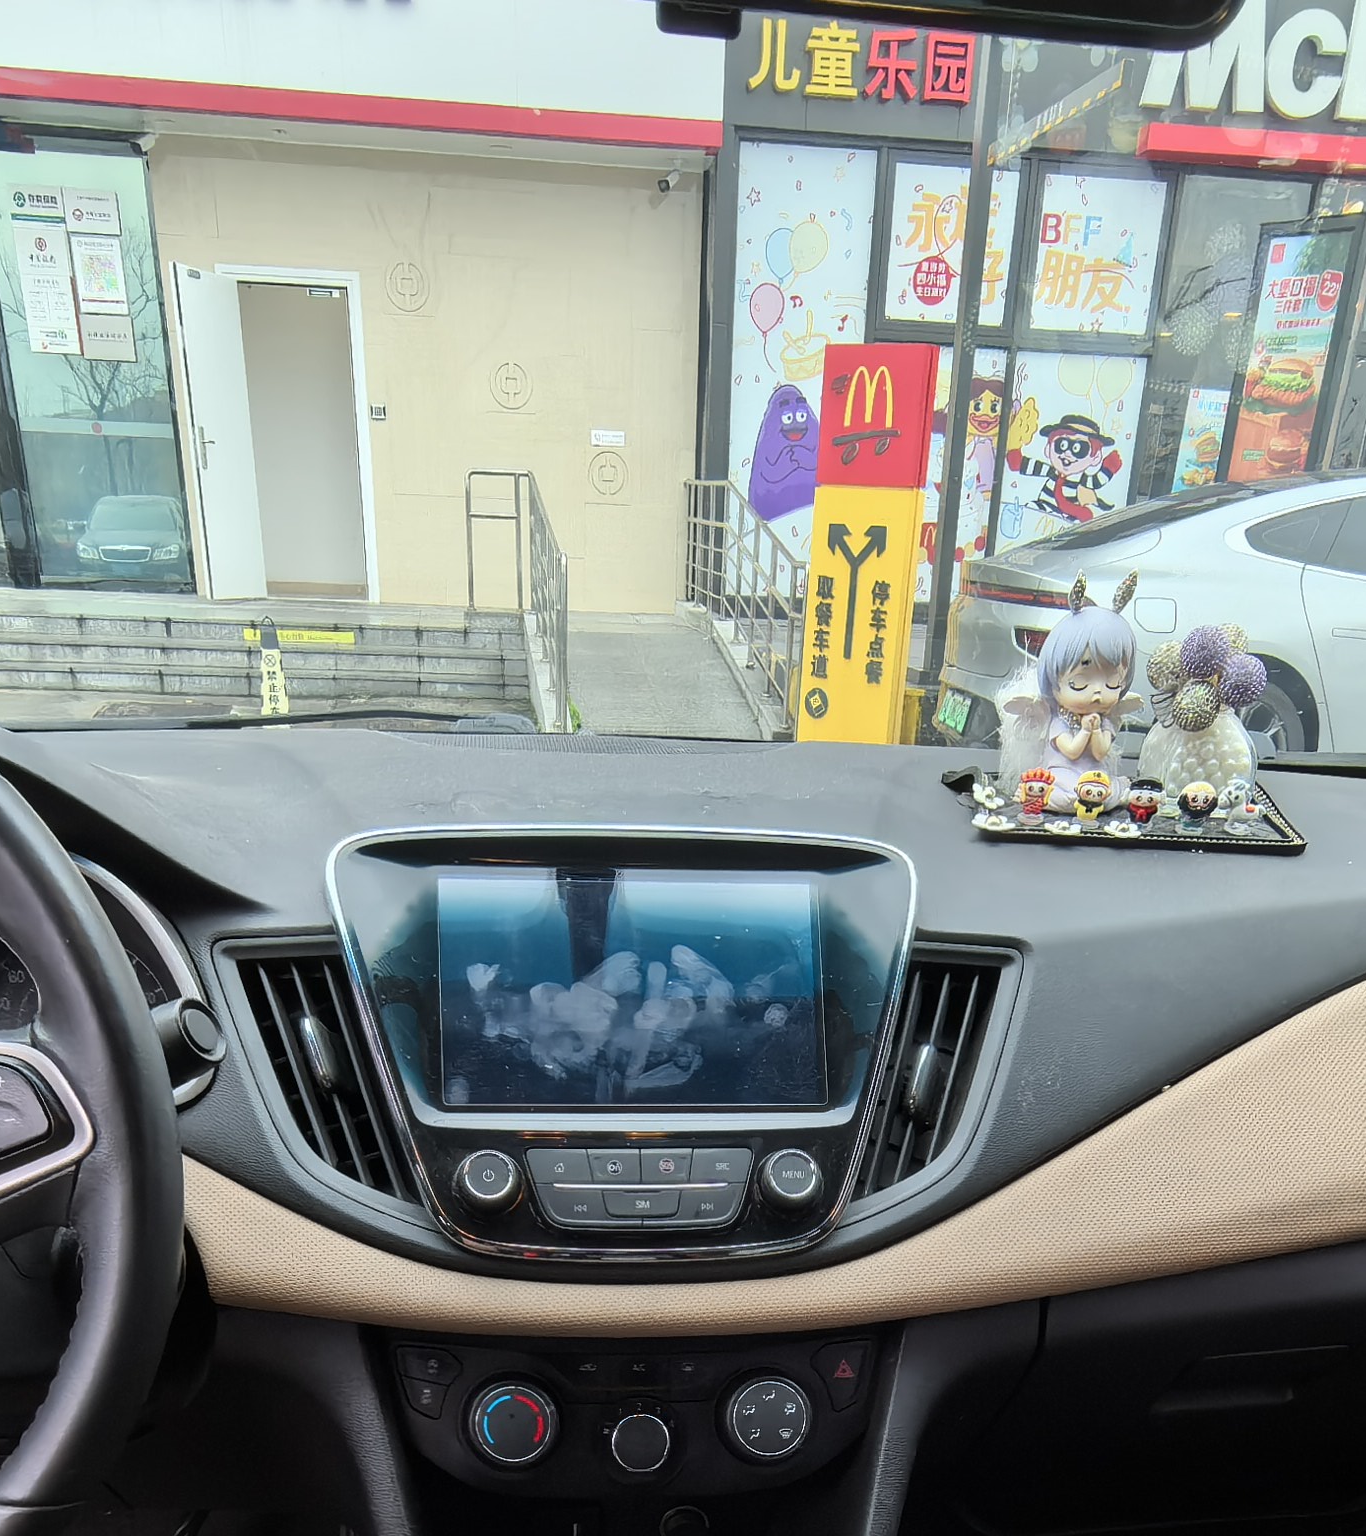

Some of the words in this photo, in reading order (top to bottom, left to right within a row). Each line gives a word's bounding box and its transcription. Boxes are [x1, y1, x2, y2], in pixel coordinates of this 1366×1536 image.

[747, 16, 976, 104] 儿童乐园
[1040, 213, 1103, 247] BFF
[810, 575, 835, 679] 取餐车道
[865, 580, 891, 684] 停车点餐
[782, 1169, 805, 1179] MENU
